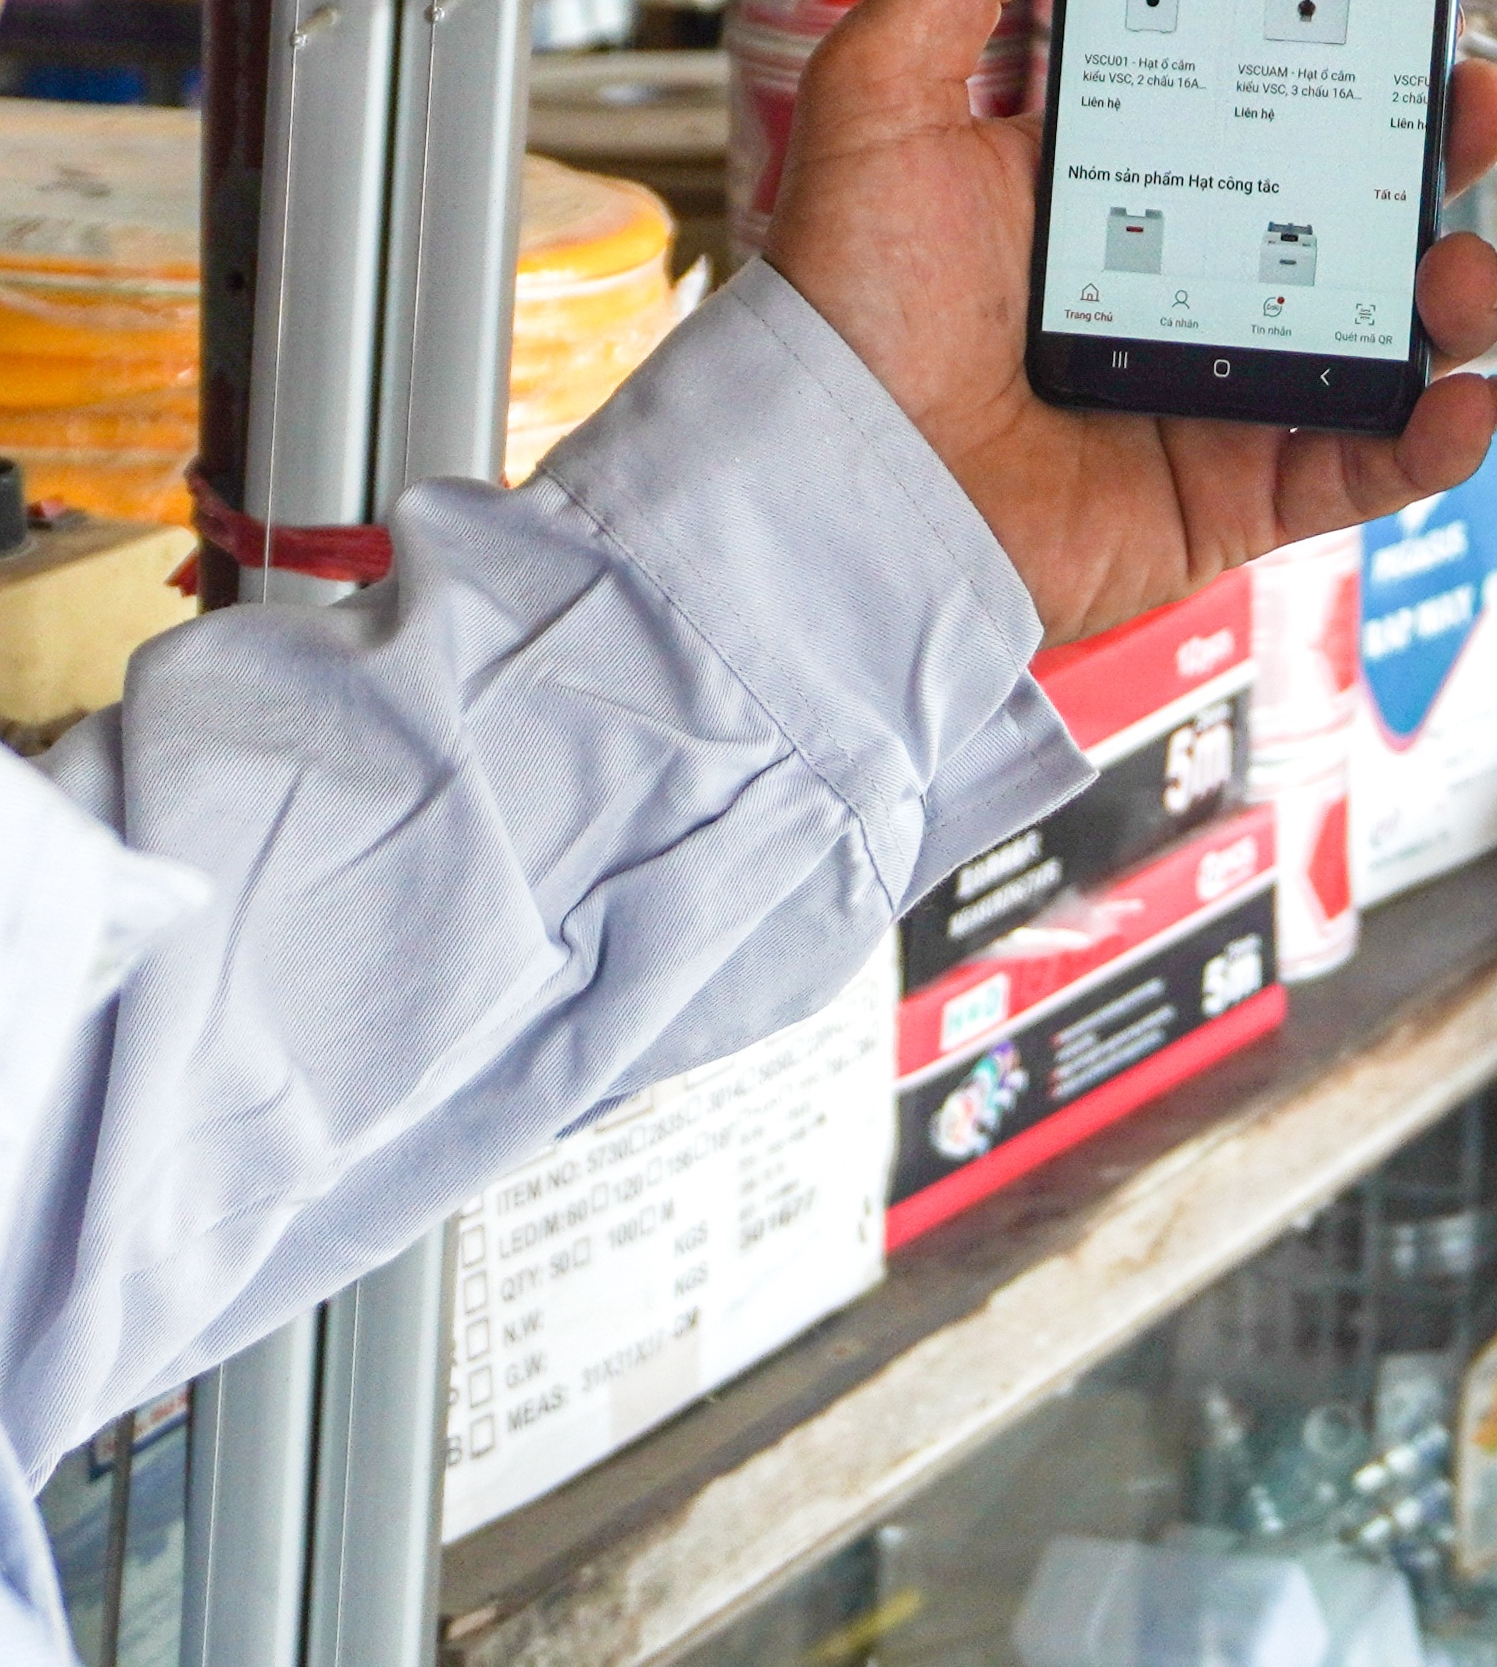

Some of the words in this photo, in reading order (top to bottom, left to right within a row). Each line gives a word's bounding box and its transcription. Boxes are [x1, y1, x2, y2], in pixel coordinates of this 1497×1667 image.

[1084, 54, 1128, 67] VSCU01
[1139, 57, 1158, 70] Hạt
[1083, 70, 1105, 82] kiểu
[1109, 72, 1134, 86] VSC,
[1137, 74, 1144, 85] 2
[1147, 75, 1174, 87] chấu
[1238, 64, 1288, 77] VSCUAM
[1298, 68, 1317, 81] Hạt
[1236, 80, 1259, 93] kiểu
[1263, 83, 1288, 97] VSC,
[1291, 85, 1298, 96] 3
[1302, 85, 1329, 97] chấu
[1081, 96, 1103, 108] Liên
[1107, 97, 1121, 111] hệ
[1392, 91, 1399, 102] 2
[1234, 106, 1258, 119] Liên
[1261, 108, 1275, 122] hệ
[1390, 117, 1414, 129] Liên
[1417, 118, 1427, 130] h
[1068, 165, 1110, 181] Nhóm
[1114, 168, 1140, 183] sản
[1144, 170, 1184, 187] phẩm
[1189, 174, 1213, 191] Hạt
[1217, 177, 1253, 195] công
[1258, 178, 1280, 194] tắc
[1374, 188, 1391, 200] Tất
[1394, 189, 1407, 201] cả
[1065, 309, 1091, 322] Trang
[1094, 311, 1113, 322] Chủ
[1160, 316, 1173, 327] Cá
[1175, 318, 1199, 329] nhân
[1252, 324, 1266, 335] Tin
[1334, 331, 1357, 342] Quét
[1360, 333, 1376, 344] mã
[1378, 334, 1393, 345] QR
